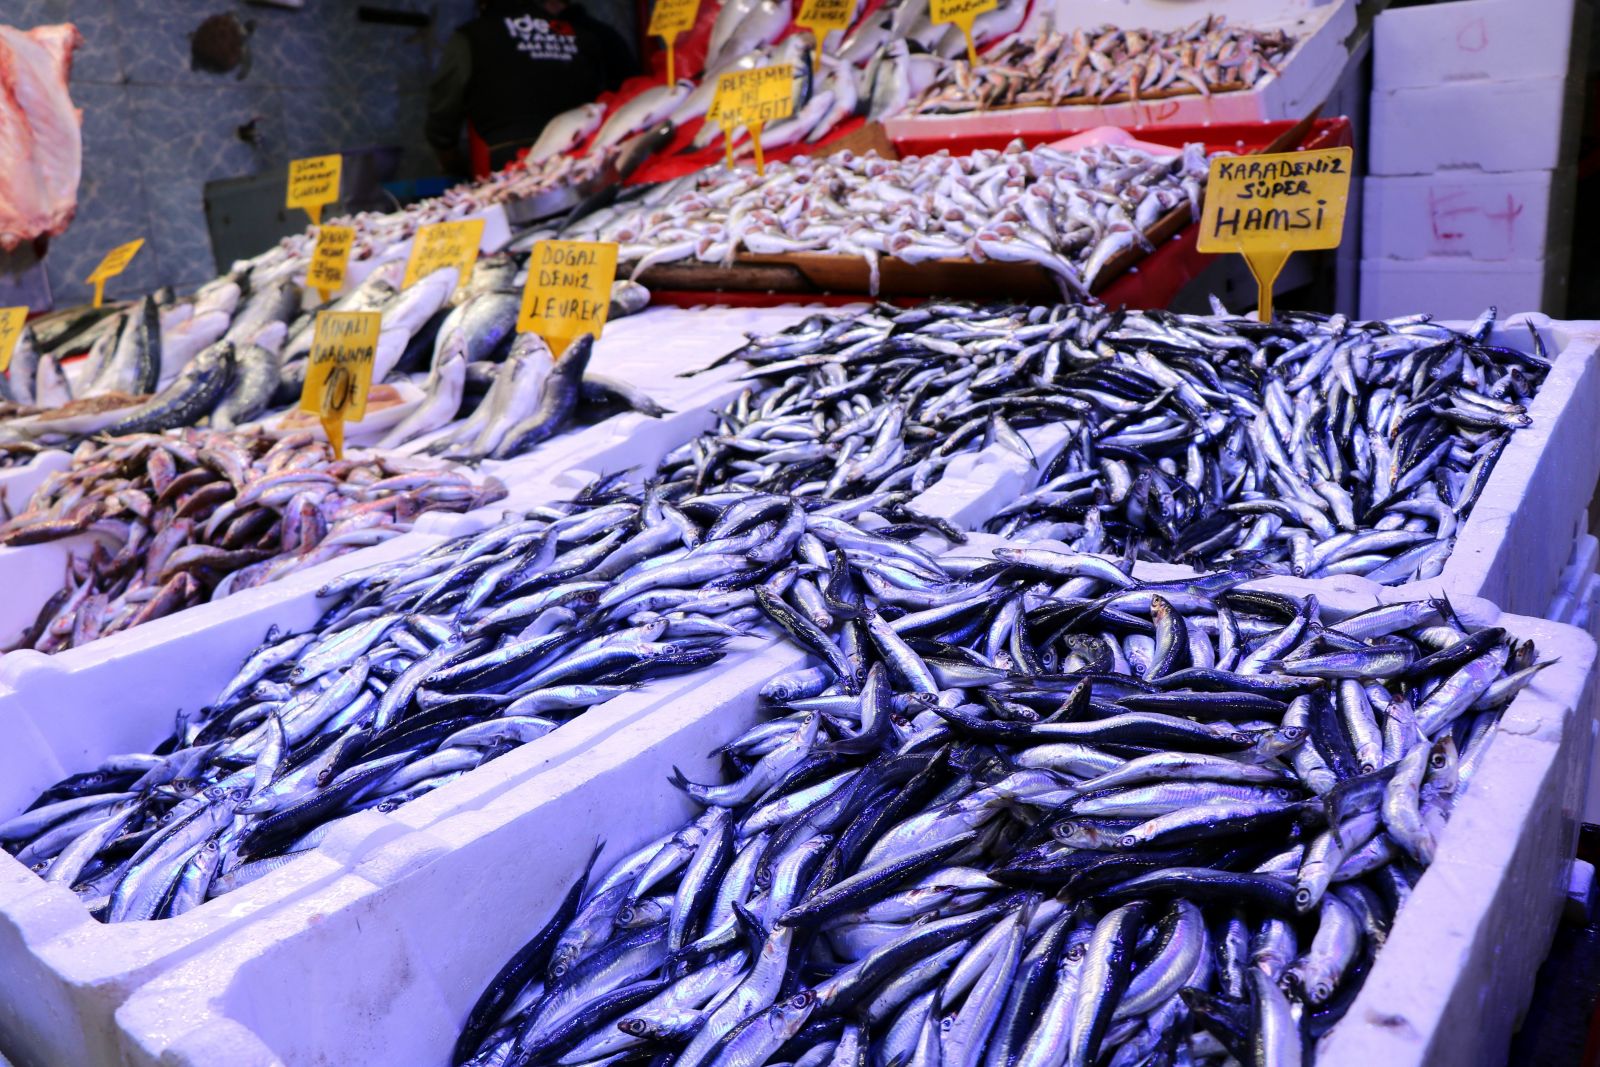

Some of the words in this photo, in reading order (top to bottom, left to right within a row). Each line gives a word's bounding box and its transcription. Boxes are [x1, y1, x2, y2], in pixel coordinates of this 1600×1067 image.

[1219, 155, 1346, 181] KARADENİZ
[1237, 180, 1311, 199] SÜPER
[1214, 199, 1327, 237] HAMSİ
[541, 244, 597, 266] DOĞAL
[530, 295, 605, 328] LEVREK
